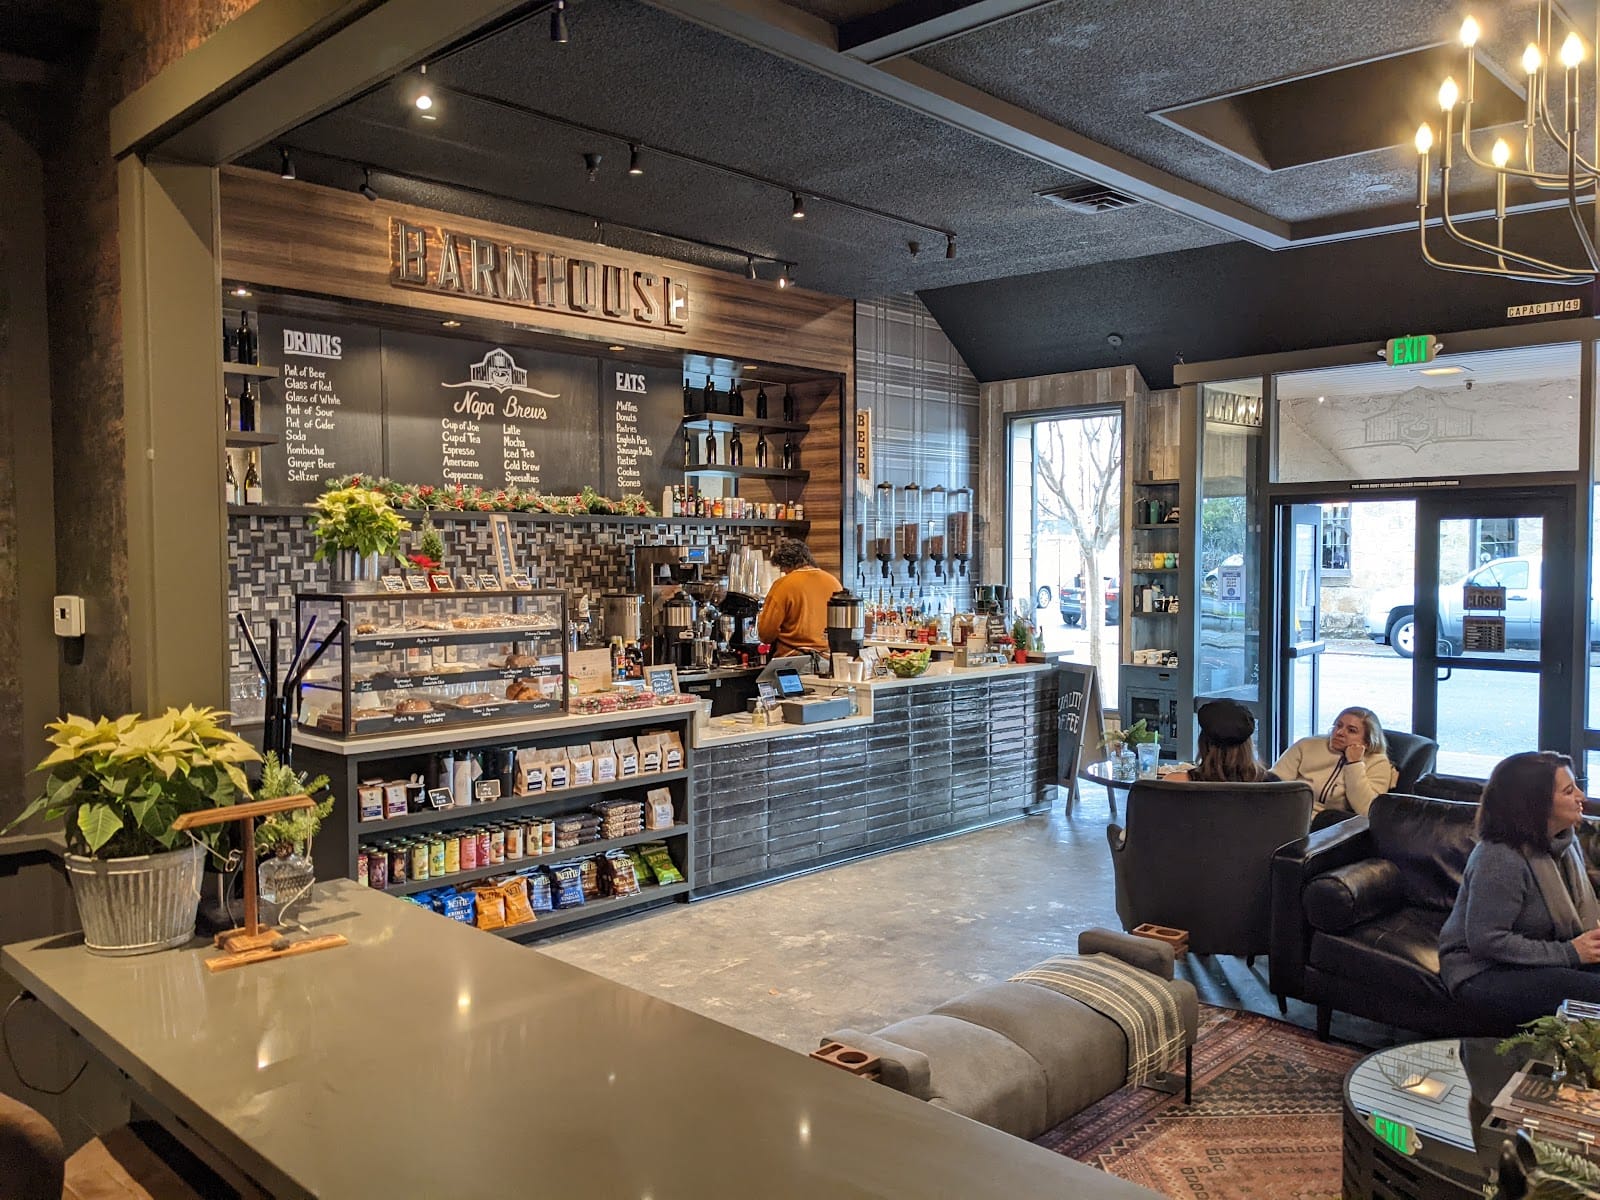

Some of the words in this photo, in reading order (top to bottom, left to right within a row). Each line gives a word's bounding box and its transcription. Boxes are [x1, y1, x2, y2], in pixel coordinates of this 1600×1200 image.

[398, 222, 689, 328] BARNHOUSE
[1508, 302, 1562, 317] CAPACITY
[1565, 300, 1580, 311] 49
[283, 329, 342, 357] DRINKS
[1394, 336, 1428, 365] EXIT
[285, 364, 298, 376] Pint
[299, 366, 308, 377] of
[309, 367, 326, 379] Beer
[285, 377, 308, 390] Glass
[310, 381, 318, 390] of
[319, 380, 332, 391] Red
[616, 372, 646, 391] EATS
[286, 390, 308, 402] Glass
[310, 394, 318, 403] of
[320, 394, 341, 405] White
[286, 404, 300, 415] Pint
[304, 406, 312, 415] of
[315, 405, 334, 417] Sour
[454, 391, 494, 420] Napa
[503, 395, 547, 419] Brews
[616, 401, 638, 412] Muffins
[286, 417, 300, 428] Pint
[304, 420, 313, 428] of
[315, 418, 335, 430] Cider
[616, 412, 637, 422] Donuts
[442, 418, 458, 432] Cup
[459, 421, 466, 430] of
[467, 421, 479, 432] Joe
[503, 424, 520, 435] Latte
[286, 429, 306, 441] Soda
[442, 431, 459, 446] Cup
[467, 432, 480, 443] Tea
[616, 434, 636, 447] English
[287, 442, 325, 455] Kombucha
[504, 436, 525, 448] Mocha
[857, 414, 865, 474] BEER
[443, 444, 475, 457] Espresso
[504, 448, 519, 458] Iced
[521, 448, 535, 458] Tea
[288, 456, 315, 471] Ginger
[318, 458, 336, 469] Beer
[443, 456, 479, 467] Americano
[504, 460, 520, 470] Cold
[522, 461, 540, 471] Brew
[288, 470, 319, 481] Seltzer
[443, 468, 483, 484] Cappuccino
[617, 467, 640, 477] Cookies
[505, 472, 539, 486] Specialties
[618, 477, 640, 487] Scones
[1058, 691, 1083, 712] UALITY
